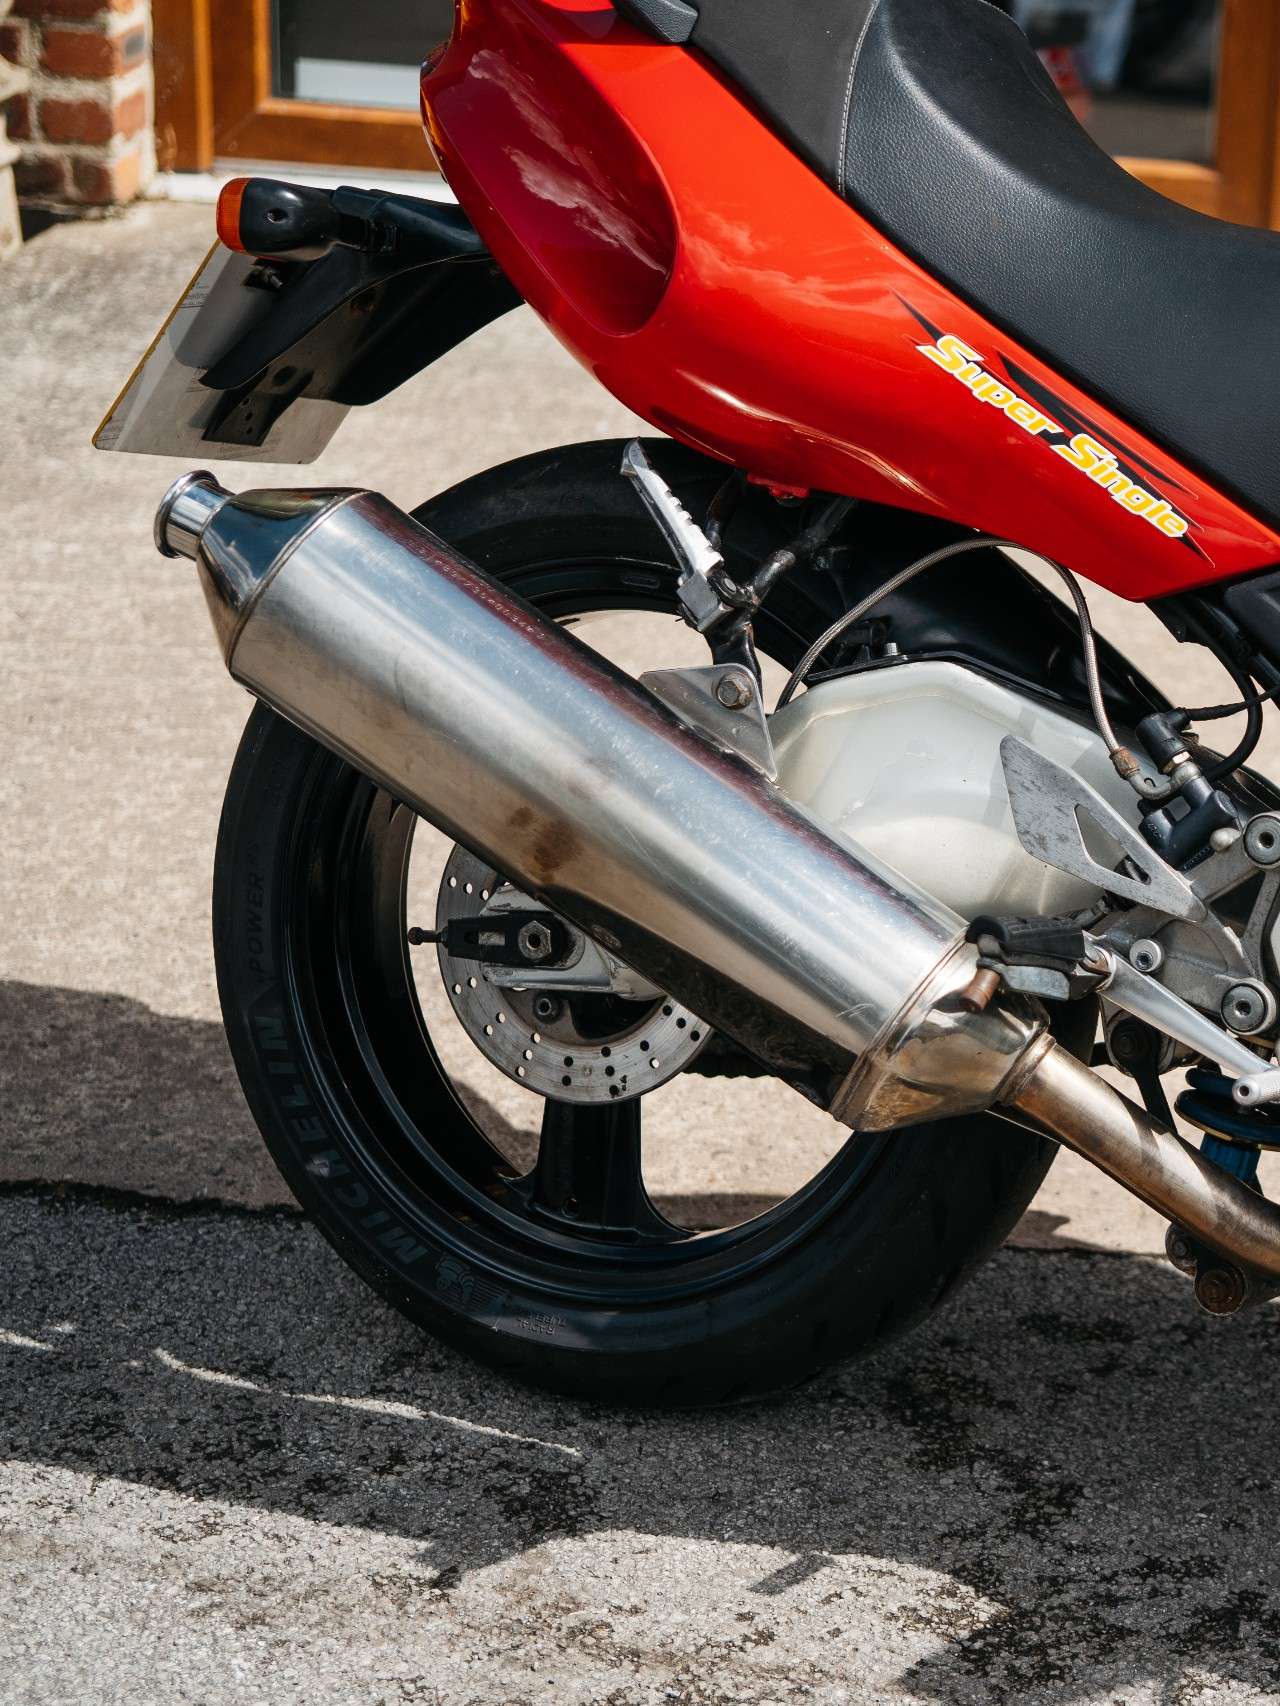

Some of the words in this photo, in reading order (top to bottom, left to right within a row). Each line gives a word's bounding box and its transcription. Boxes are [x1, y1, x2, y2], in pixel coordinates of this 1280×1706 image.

[915, 334, 1064, 435] Super
[1050, 433, 1189, 537] Single
[247, 871, 267, 975] POWER
[253, 1014, 430, 1266] MICHELIN
